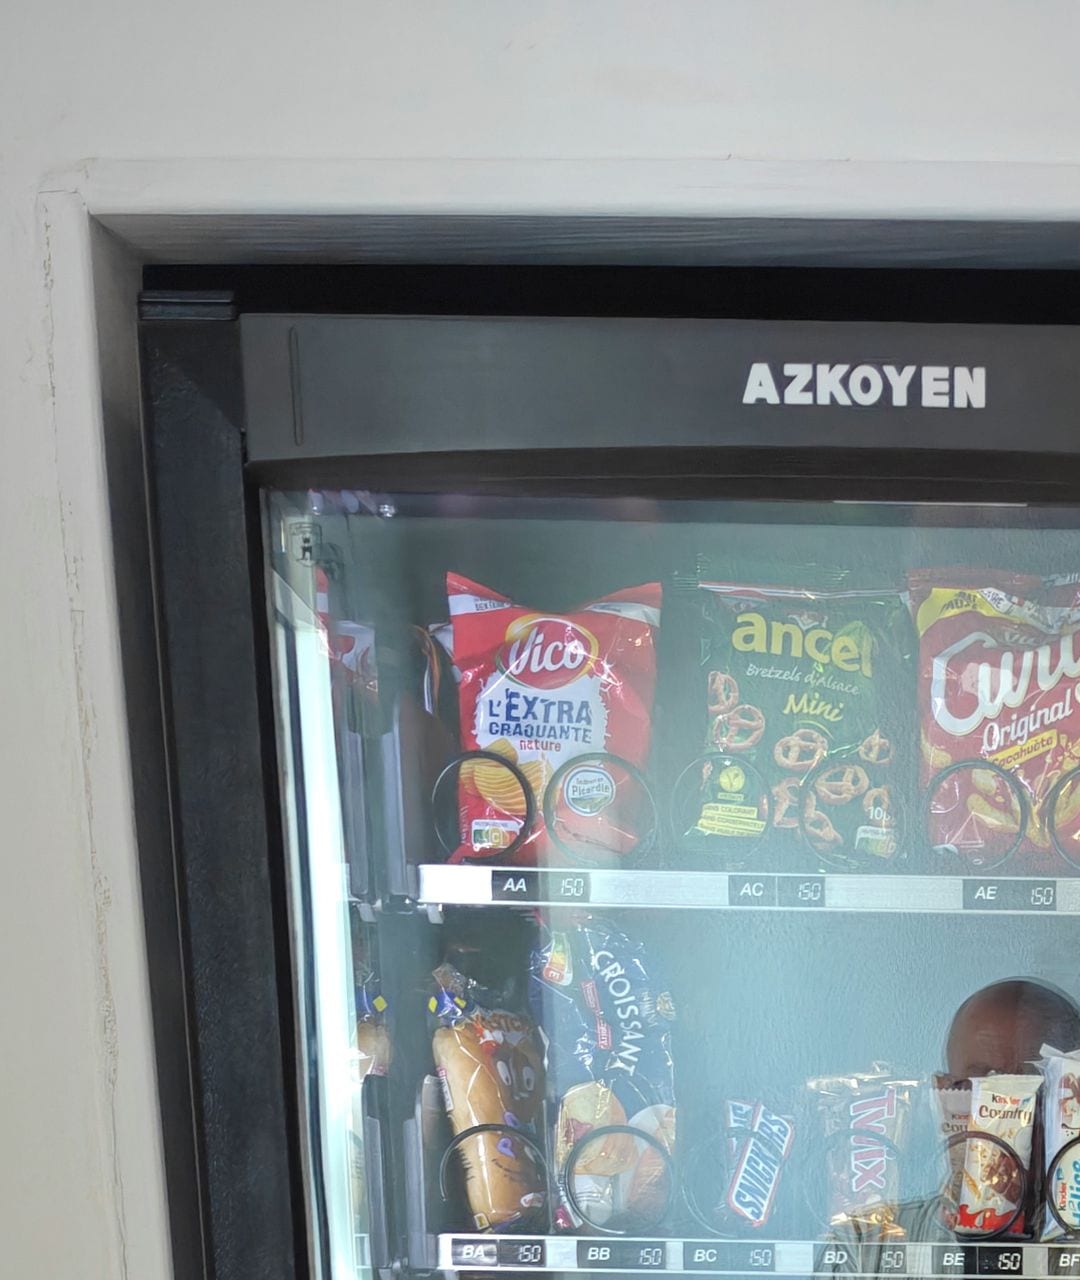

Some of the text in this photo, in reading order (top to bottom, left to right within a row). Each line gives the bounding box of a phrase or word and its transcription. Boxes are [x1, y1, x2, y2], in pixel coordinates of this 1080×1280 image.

[743, 362, 986, 409] AZKOYEN
[509, 626, 586, 676] Vico
[732, 612, 872, 679] ancel
[746, 663, 800, 683] Bretzels
[488, 687, 592, 725] L'EXTRA
[783, 692, 845, 722] Mini
[982, 688, 1074, 753] Original
[488, 721, 592, 744] CRAQUANTE
[519, 738, 562, 752] nature
[503, 878, 527, 892] AA
[560, 878, 584, 896] 150
[740, 882, 764, 896] AC
[799, 882, 821, 900] 150
[975, 886, 997, 899] AE
[1030, 887, 1053, 905] 150
[593, 950, 645, 1077] CROISSANT
[850, 1087, 897, 1192] TWIX
[462, 1247, 485, 1259] BA
[517, 1247, 541, 1262] 150
[587, 1247, 611, 1261] BB
[640, 1248, 663, 1265] 150
[693, 1250, 718, 1262] BC
[750, 1249, 772, 1266] 150
[824, 1251, 848, 1264] BD
[882, 1252, 904, 1268] 150
[943, 1252, 966, 1266] BE
[998, 1253, 1021, 1270] 150
[1059, 1253, 1080, 1267] BF
